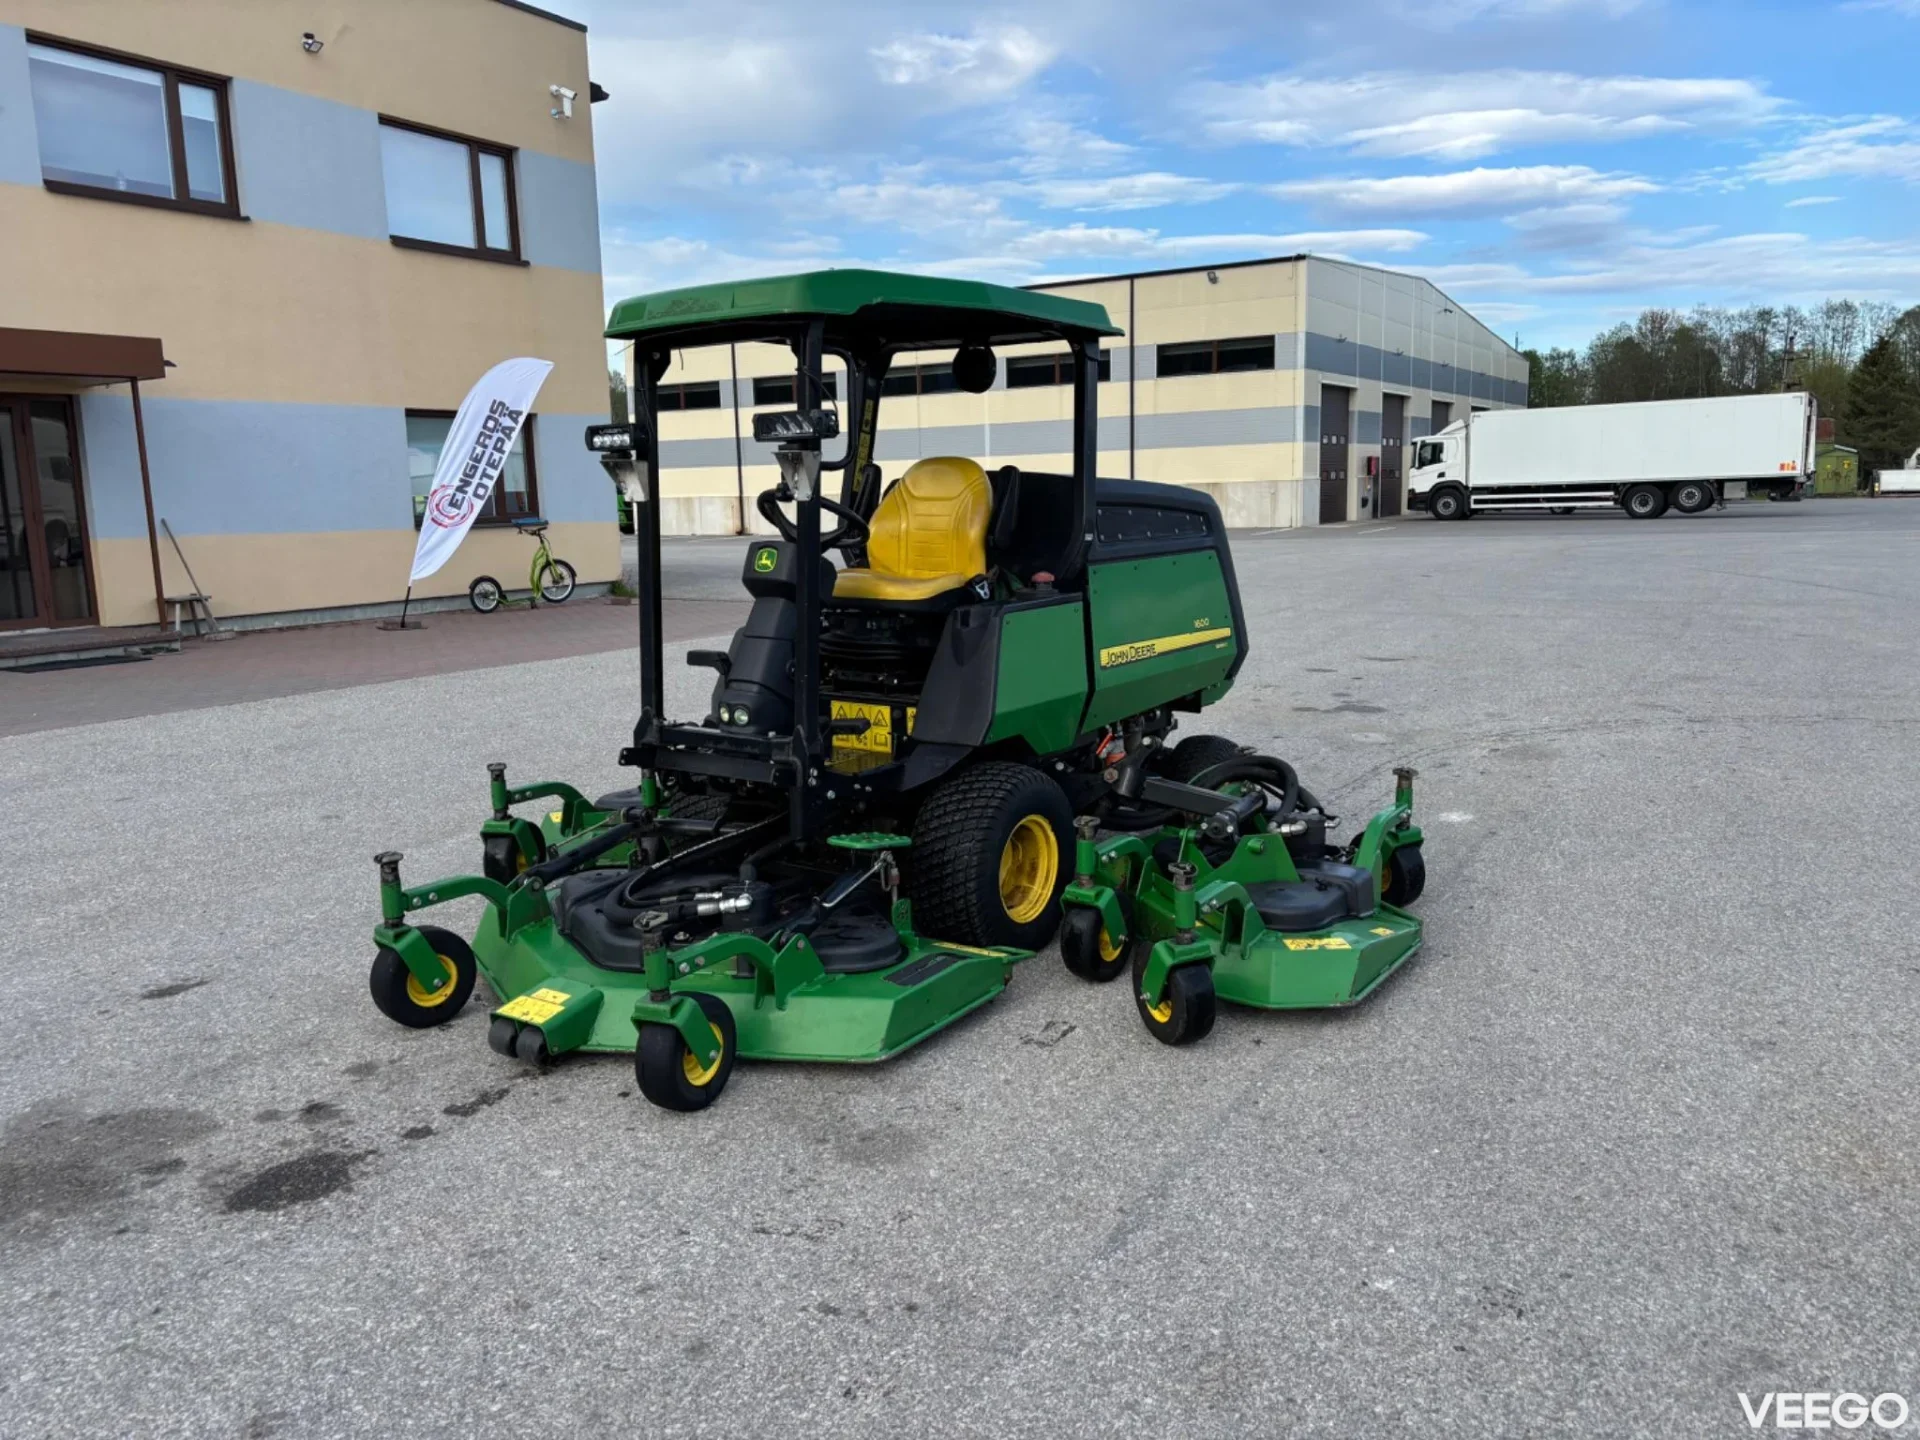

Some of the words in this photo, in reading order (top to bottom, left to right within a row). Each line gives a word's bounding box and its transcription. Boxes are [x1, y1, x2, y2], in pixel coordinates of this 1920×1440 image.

[448, 399, 507, 510] ENGEROS
[472, 406, 523, 501] OTEPÄÄ
[1106, 649, 1129, 666] JOHN
[1129, 643, 1157, 661] DEERE
